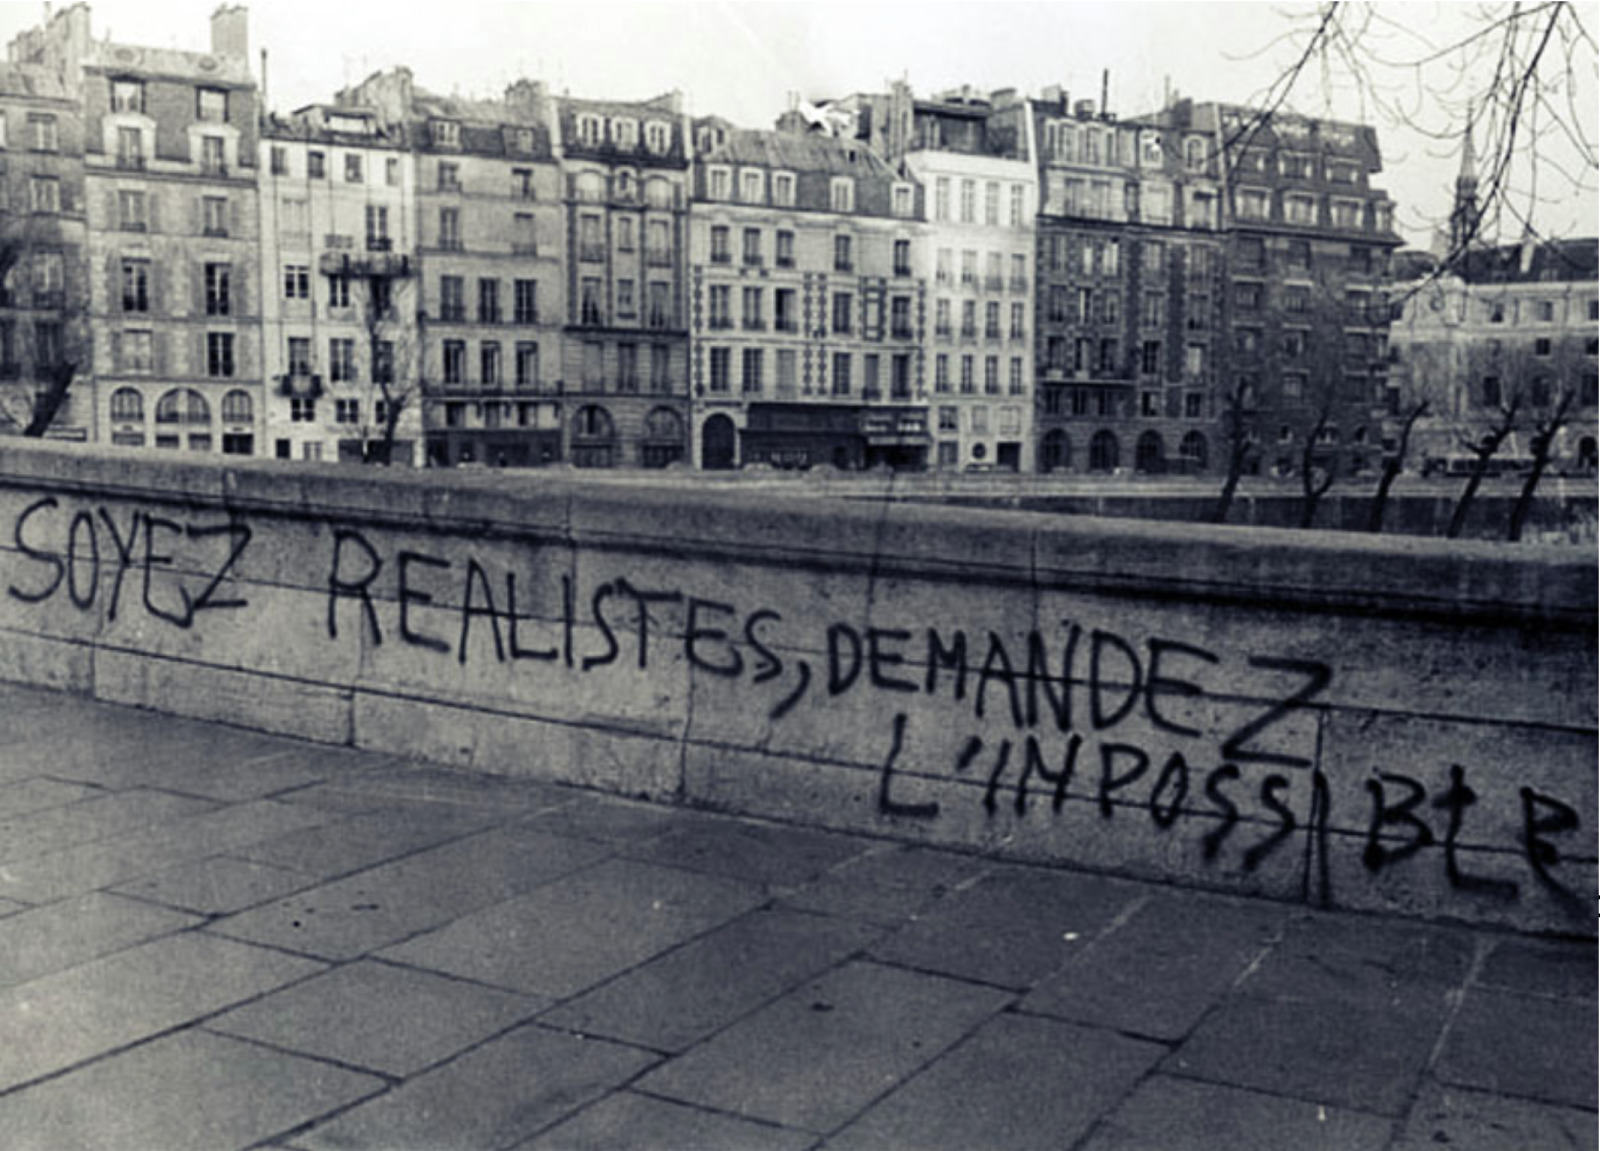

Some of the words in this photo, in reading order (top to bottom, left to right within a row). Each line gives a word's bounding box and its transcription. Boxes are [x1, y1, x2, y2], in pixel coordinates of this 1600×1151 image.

[8, 497, 252, 628] SOYEZ
[327, 528, 812, 718] REALISTES,
[825, 622, 1334, 768] DEMANDEZ
